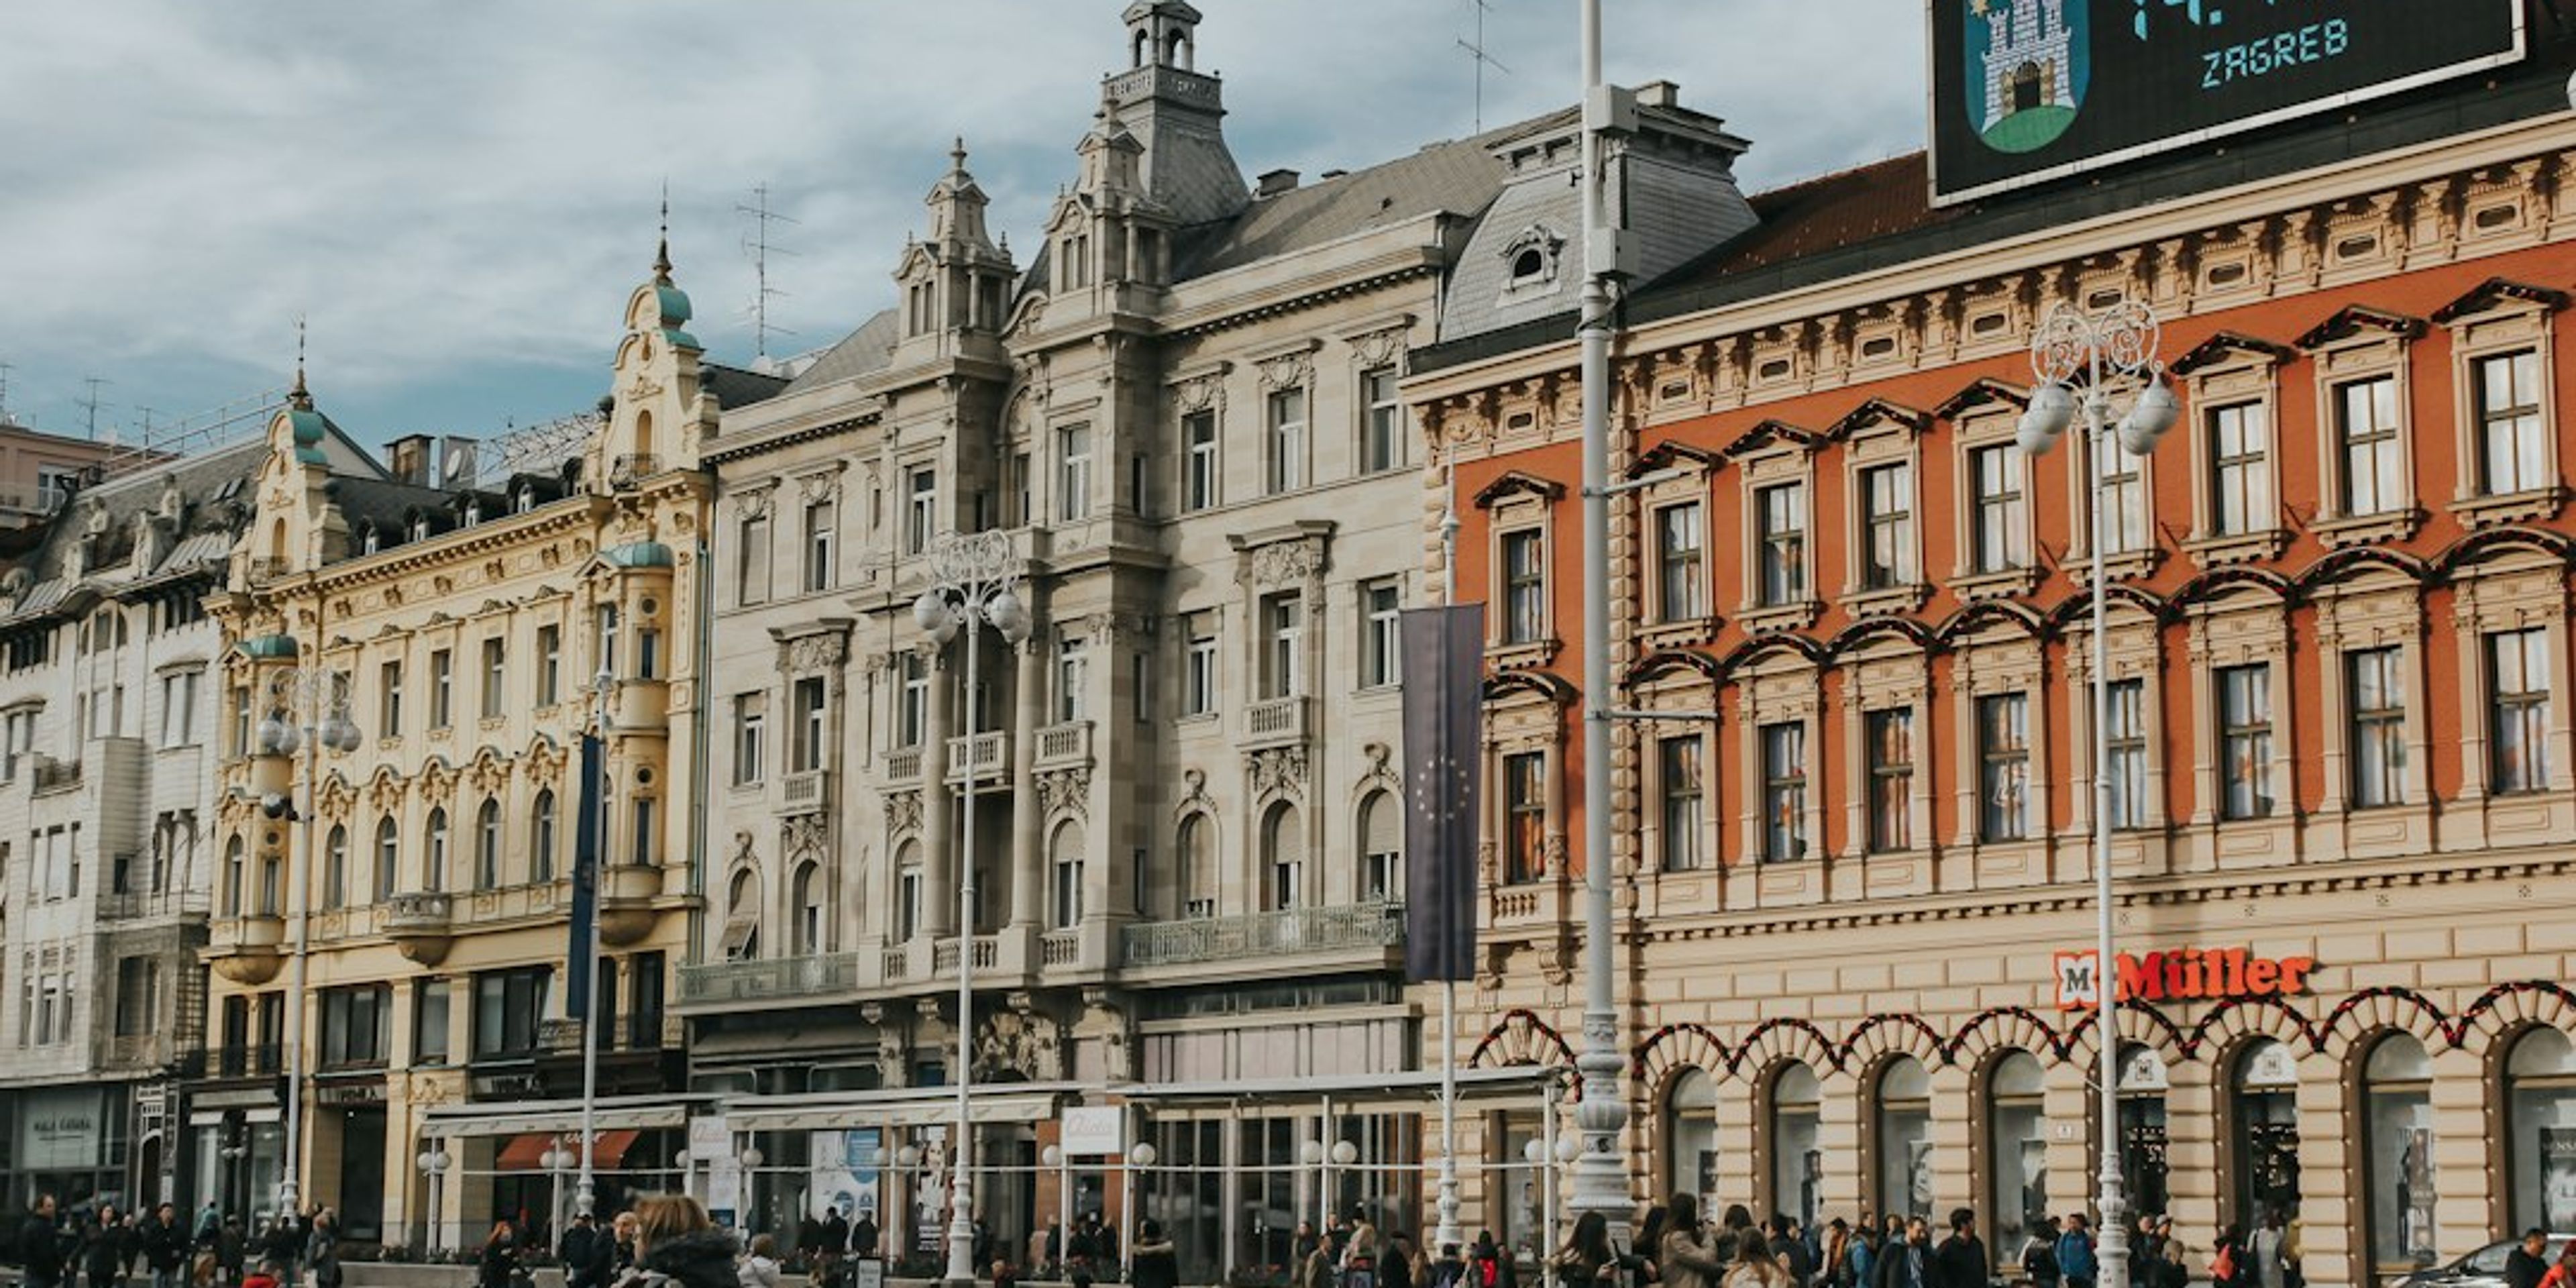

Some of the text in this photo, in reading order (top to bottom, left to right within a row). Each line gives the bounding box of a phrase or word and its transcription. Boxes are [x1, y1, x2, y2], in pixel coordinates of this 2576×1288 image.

[2200, 17, 2348, 89] ZAGREB
[2065, 947, 2313, 1001] M Müller
